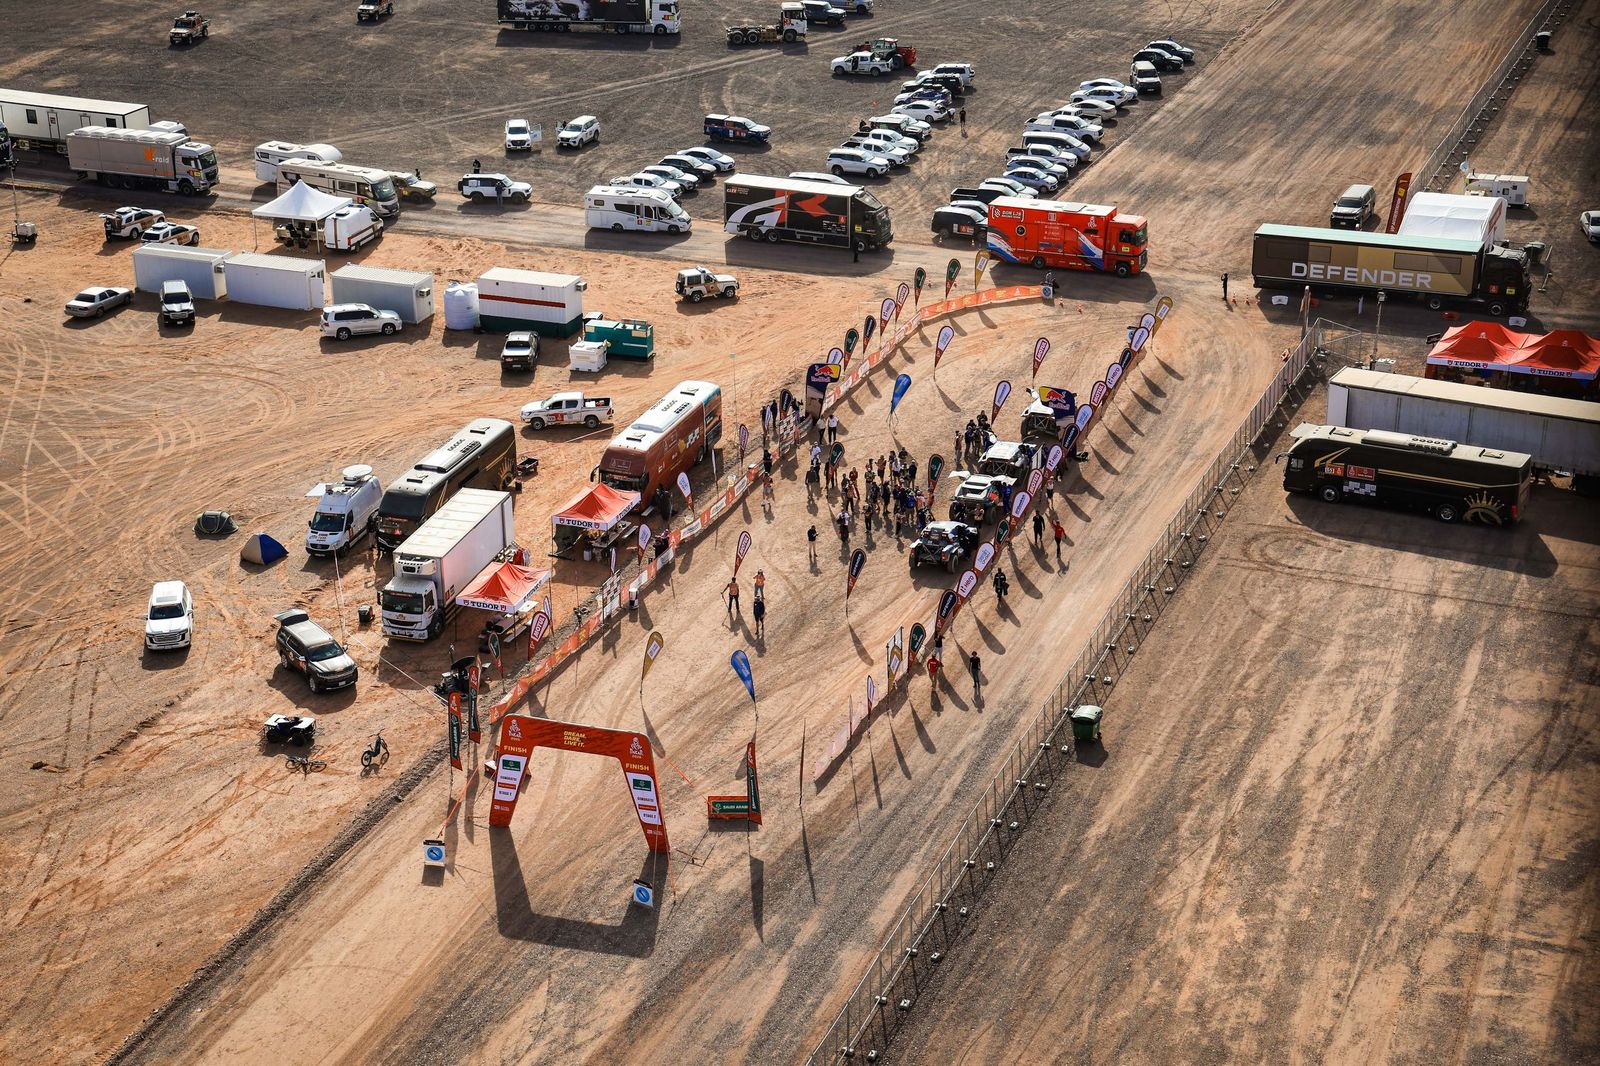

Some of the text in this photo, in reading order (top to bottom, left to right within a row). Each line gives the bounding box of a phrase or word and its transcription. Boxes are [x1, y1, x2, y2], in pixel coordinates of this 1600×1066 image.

[1291, 262, 1432, 288] DEFENDER
[1036, 341, 1048, 359] MOTUL
[1453, 360, 1481, 368] TUDOR
[1537, 369, 1565, 377] TUDOR
[1092, 384, 1105, 404] MOTUL
[1028, 472, 1040, 494] MOTUL
[566, 519, 593, 528] TUDOR
[852, 554, 861, 576] DEFENDER
[471, 601, 499, 610] TUDOR
[941, 594, 953, 616] DEFENDER
[533, 616, 546, 639] MOTUL
[564, 731, 587, 739] DREAM.
[504, 745, 527, 753] FINISH
[625, 763, 650, 771] FINISH
